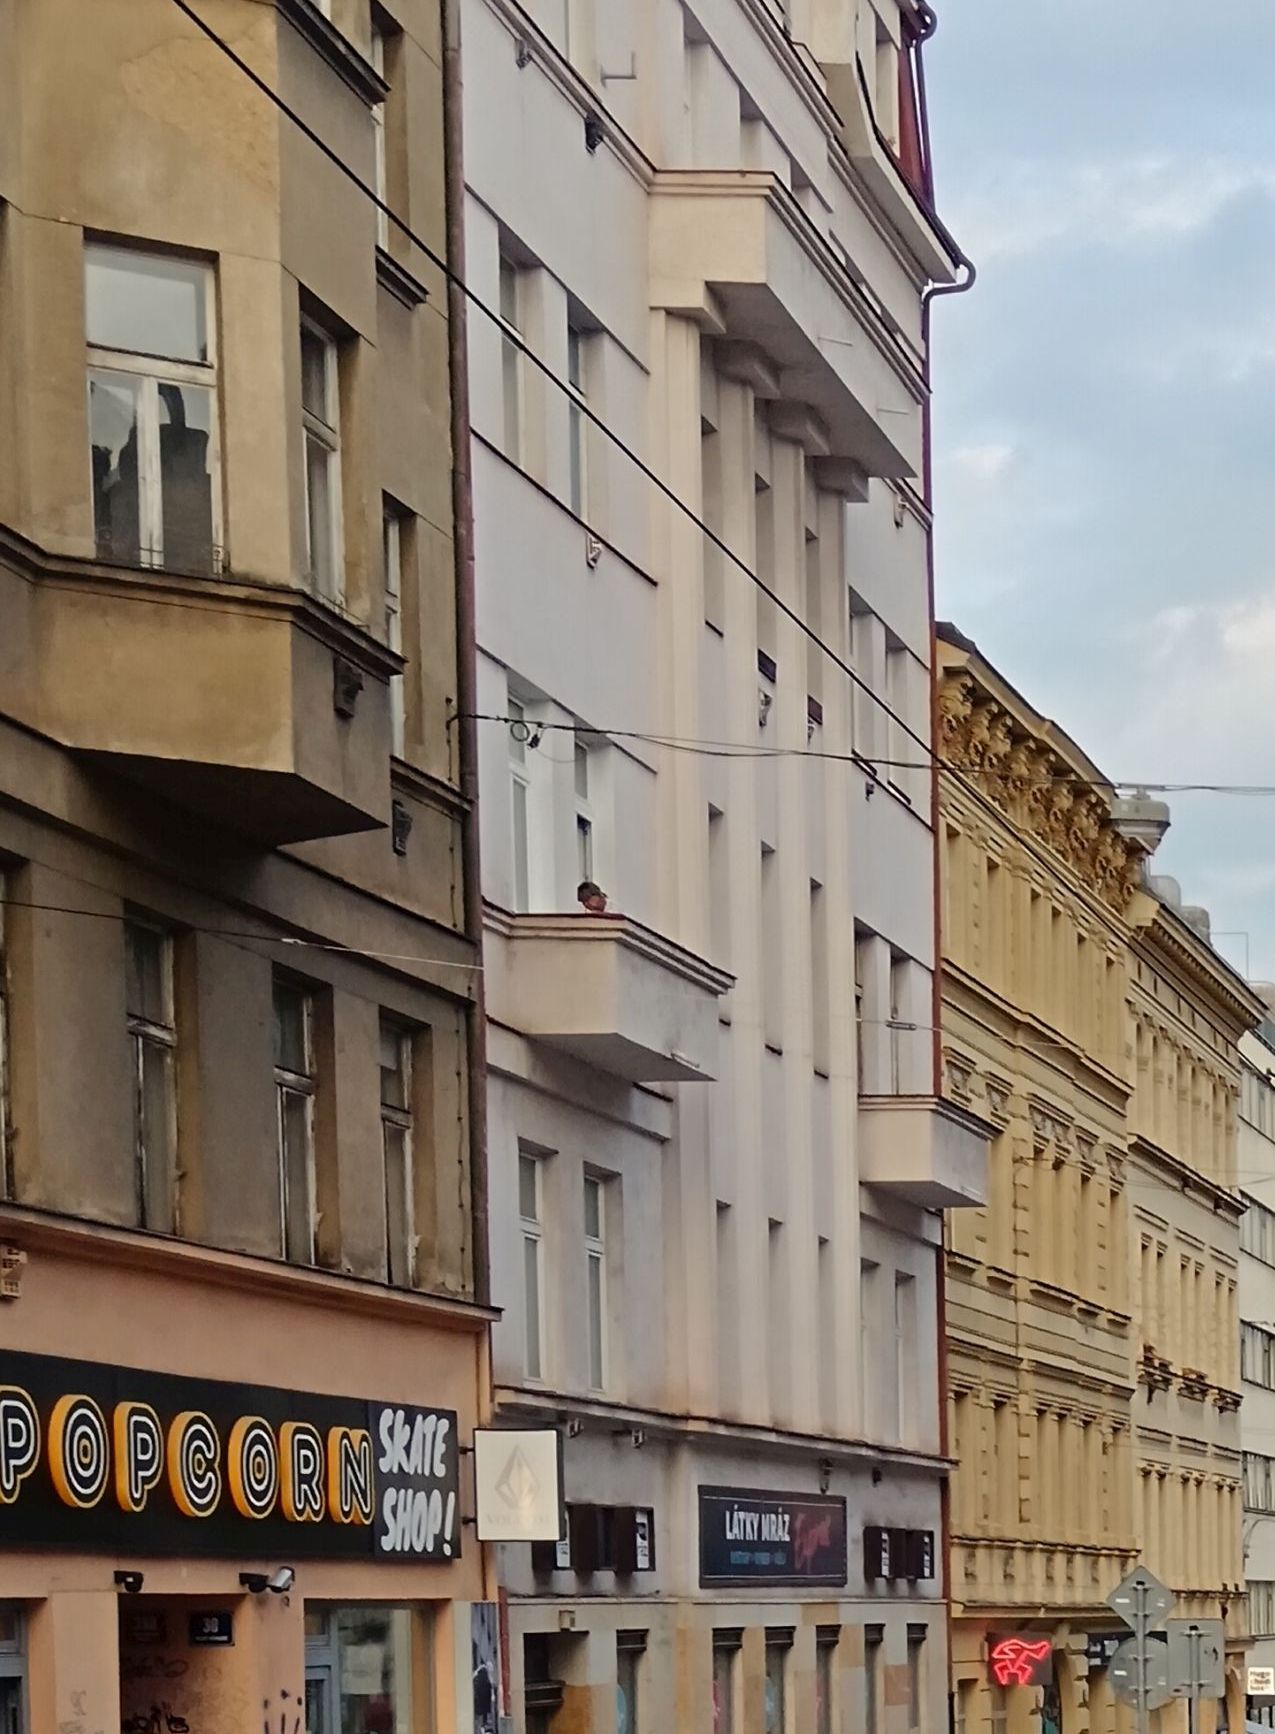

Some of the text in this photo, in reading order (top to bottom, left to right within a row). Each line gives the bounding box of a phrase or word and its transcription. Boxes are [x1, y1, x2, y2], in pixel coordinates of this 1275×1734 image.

[0, 1384, 376, 1526] POPCORN
[378, 1408, 450, 1478] SKATE
[380, 1487, 456, 1557] SHOP!
[725, 1504, 791, 1542] LÁTKY MRÁZ
